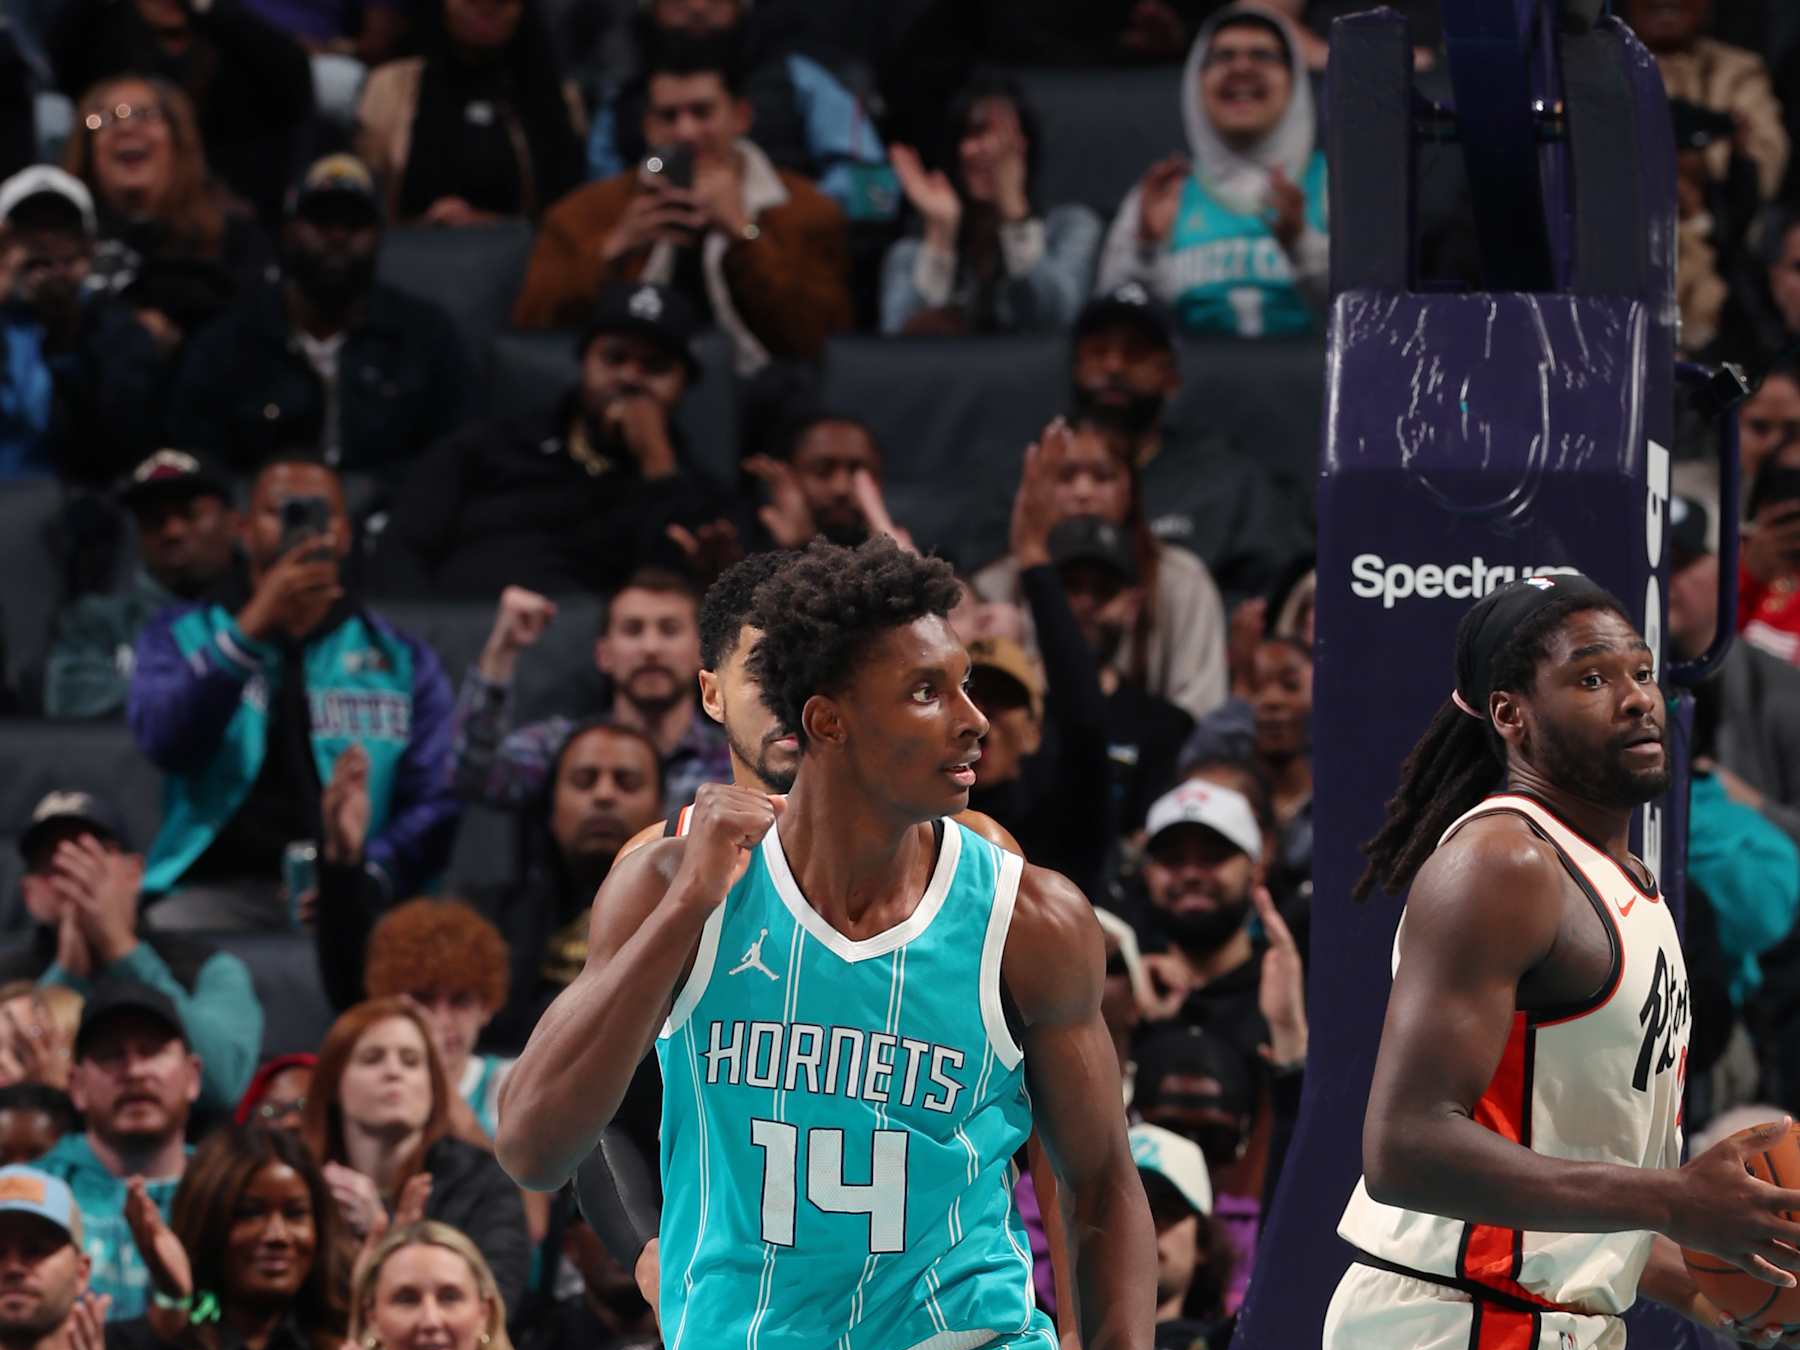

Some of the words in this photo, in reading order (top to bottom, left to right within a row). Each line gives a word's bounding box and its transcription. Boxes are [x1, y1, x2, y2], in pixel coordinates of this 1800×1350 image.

[1351, 553, 1579, 609] Spectr
[700, 1020, 966, 1113] HORNETS
[751, 1117, 909, 1254] 14
